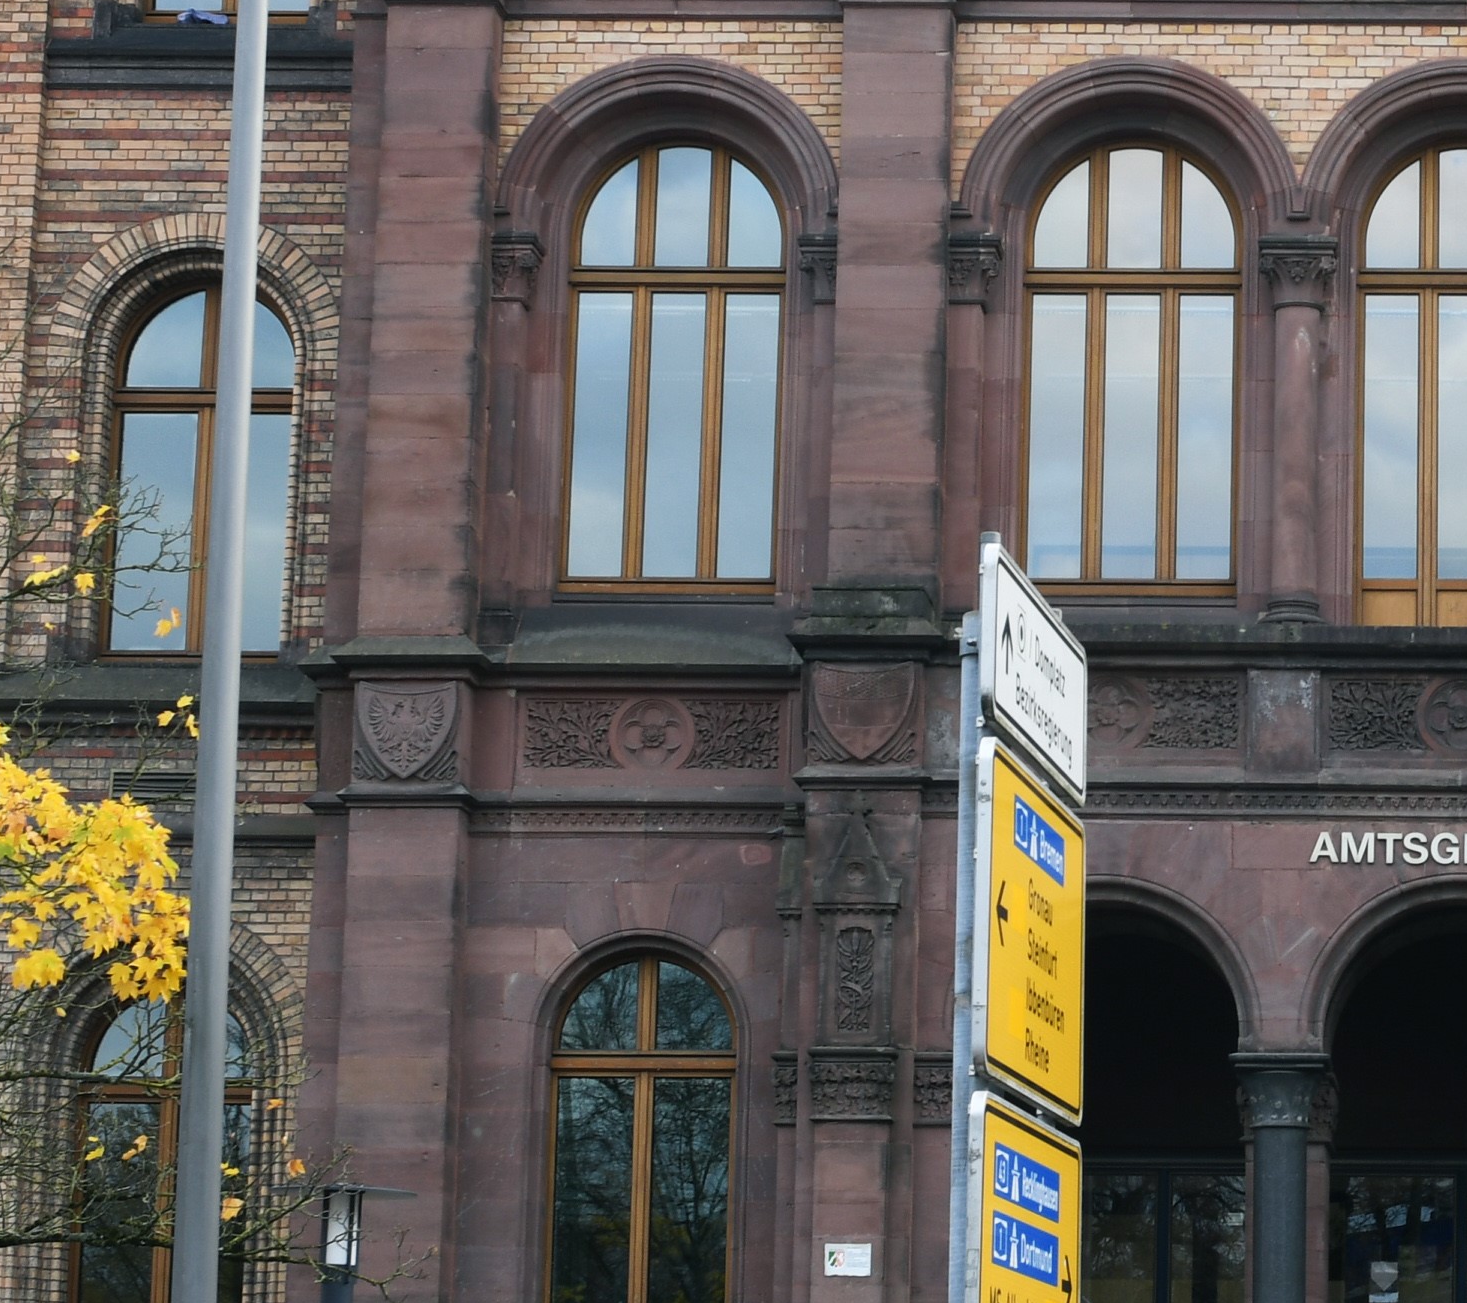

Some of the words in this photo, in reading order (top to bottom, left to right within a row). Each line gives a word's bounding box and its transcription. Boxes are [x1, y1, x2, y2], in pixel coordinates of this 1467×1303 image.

[1035, 634, 1066, 698] Domplatz
[1015, 671, 1073, 770] Bezirksregierung
[1039, 828, 1064, 876] Bremen
[1028, 877, 1053, 927] Gronau
[1027, 927, 1057, 980] Steinfurt
[1025, 976, 1065, 1035] Ibbenbüren
[1024, 1027, 1050, 1074] Rheine
[1021, 1166, 1059, 1213] Recklinghausen
[1020, 1232, 1053, 1274] Dortmund
